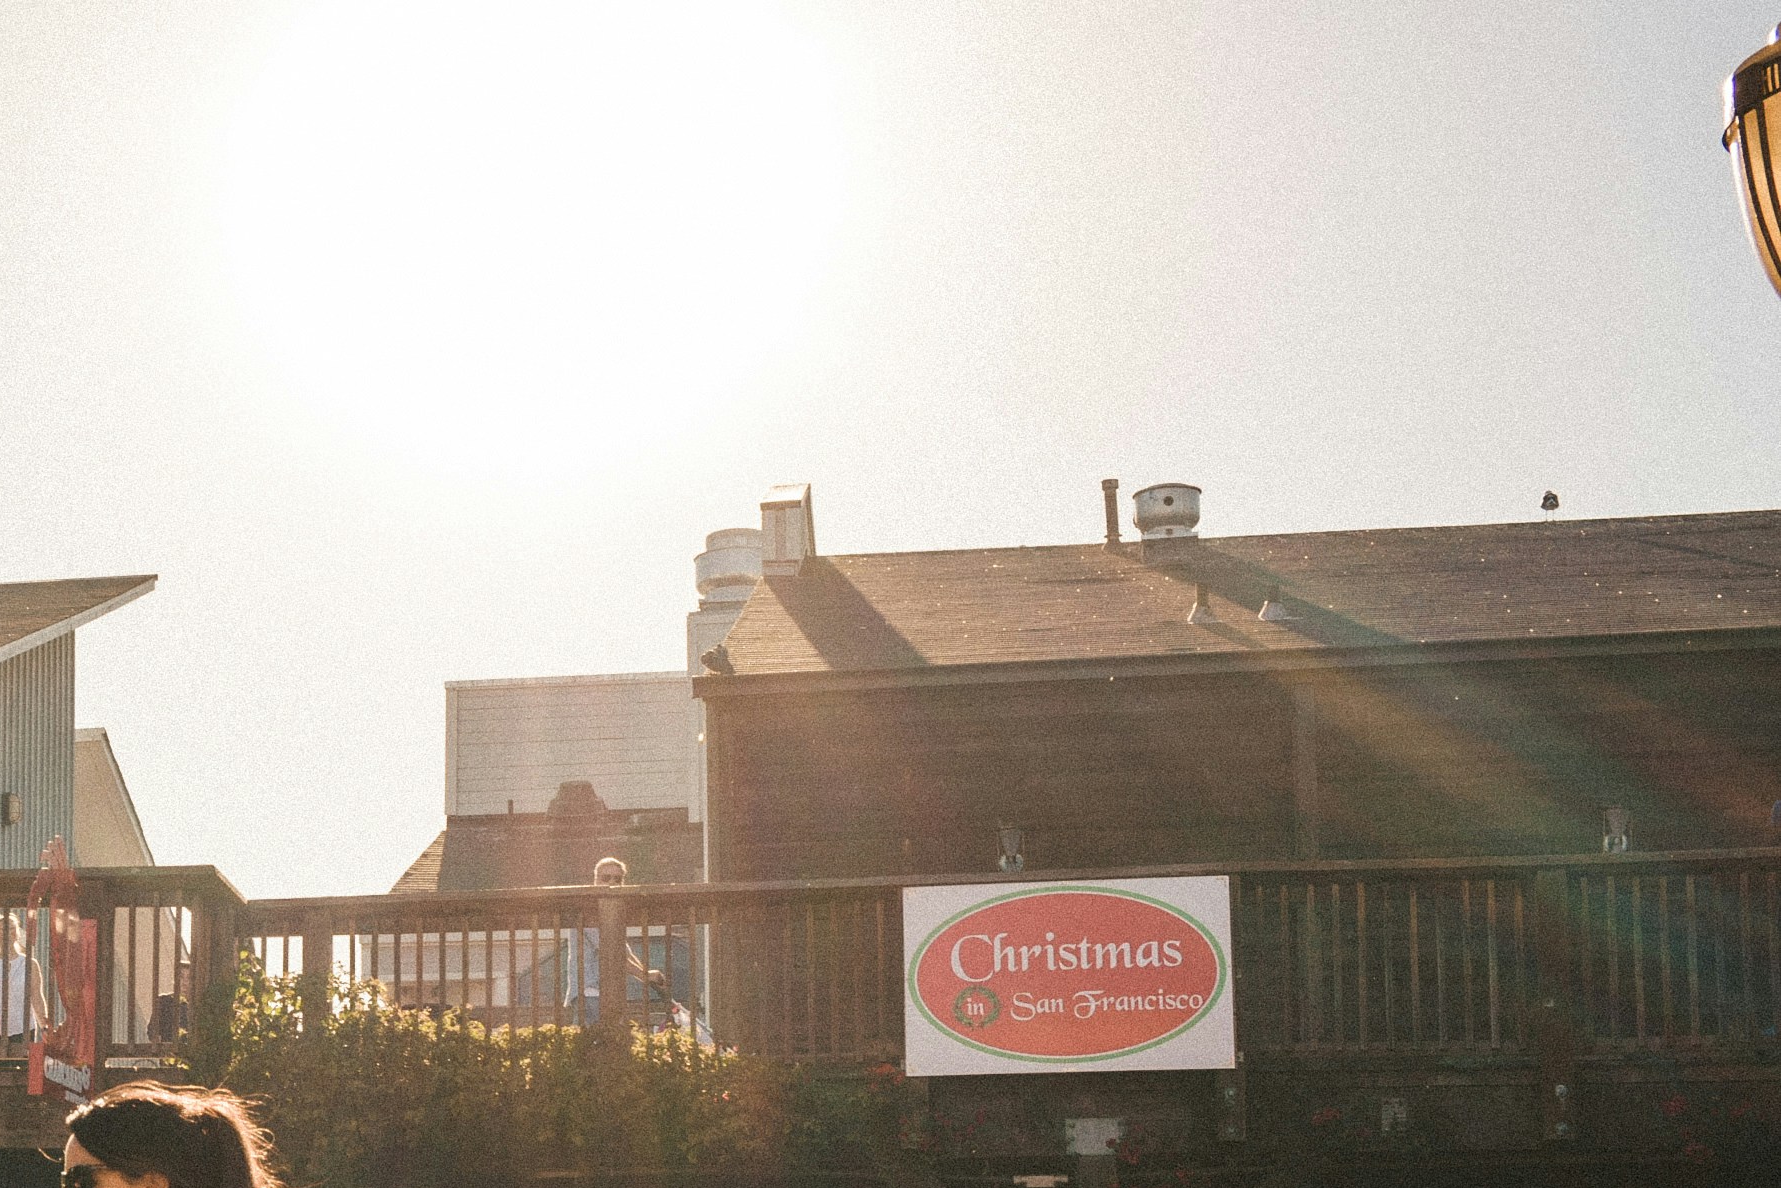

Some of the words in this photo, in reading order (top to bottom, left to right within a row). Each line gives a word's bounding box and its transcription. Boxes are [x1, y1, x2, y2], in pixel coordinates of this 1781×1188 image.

[950, 932, 1183, 983] Christmas
[966, 997, 985, 1016] in
[1010, 991, 1064, 1021] San
[1072, 989, 1204, 1019] Francisco
